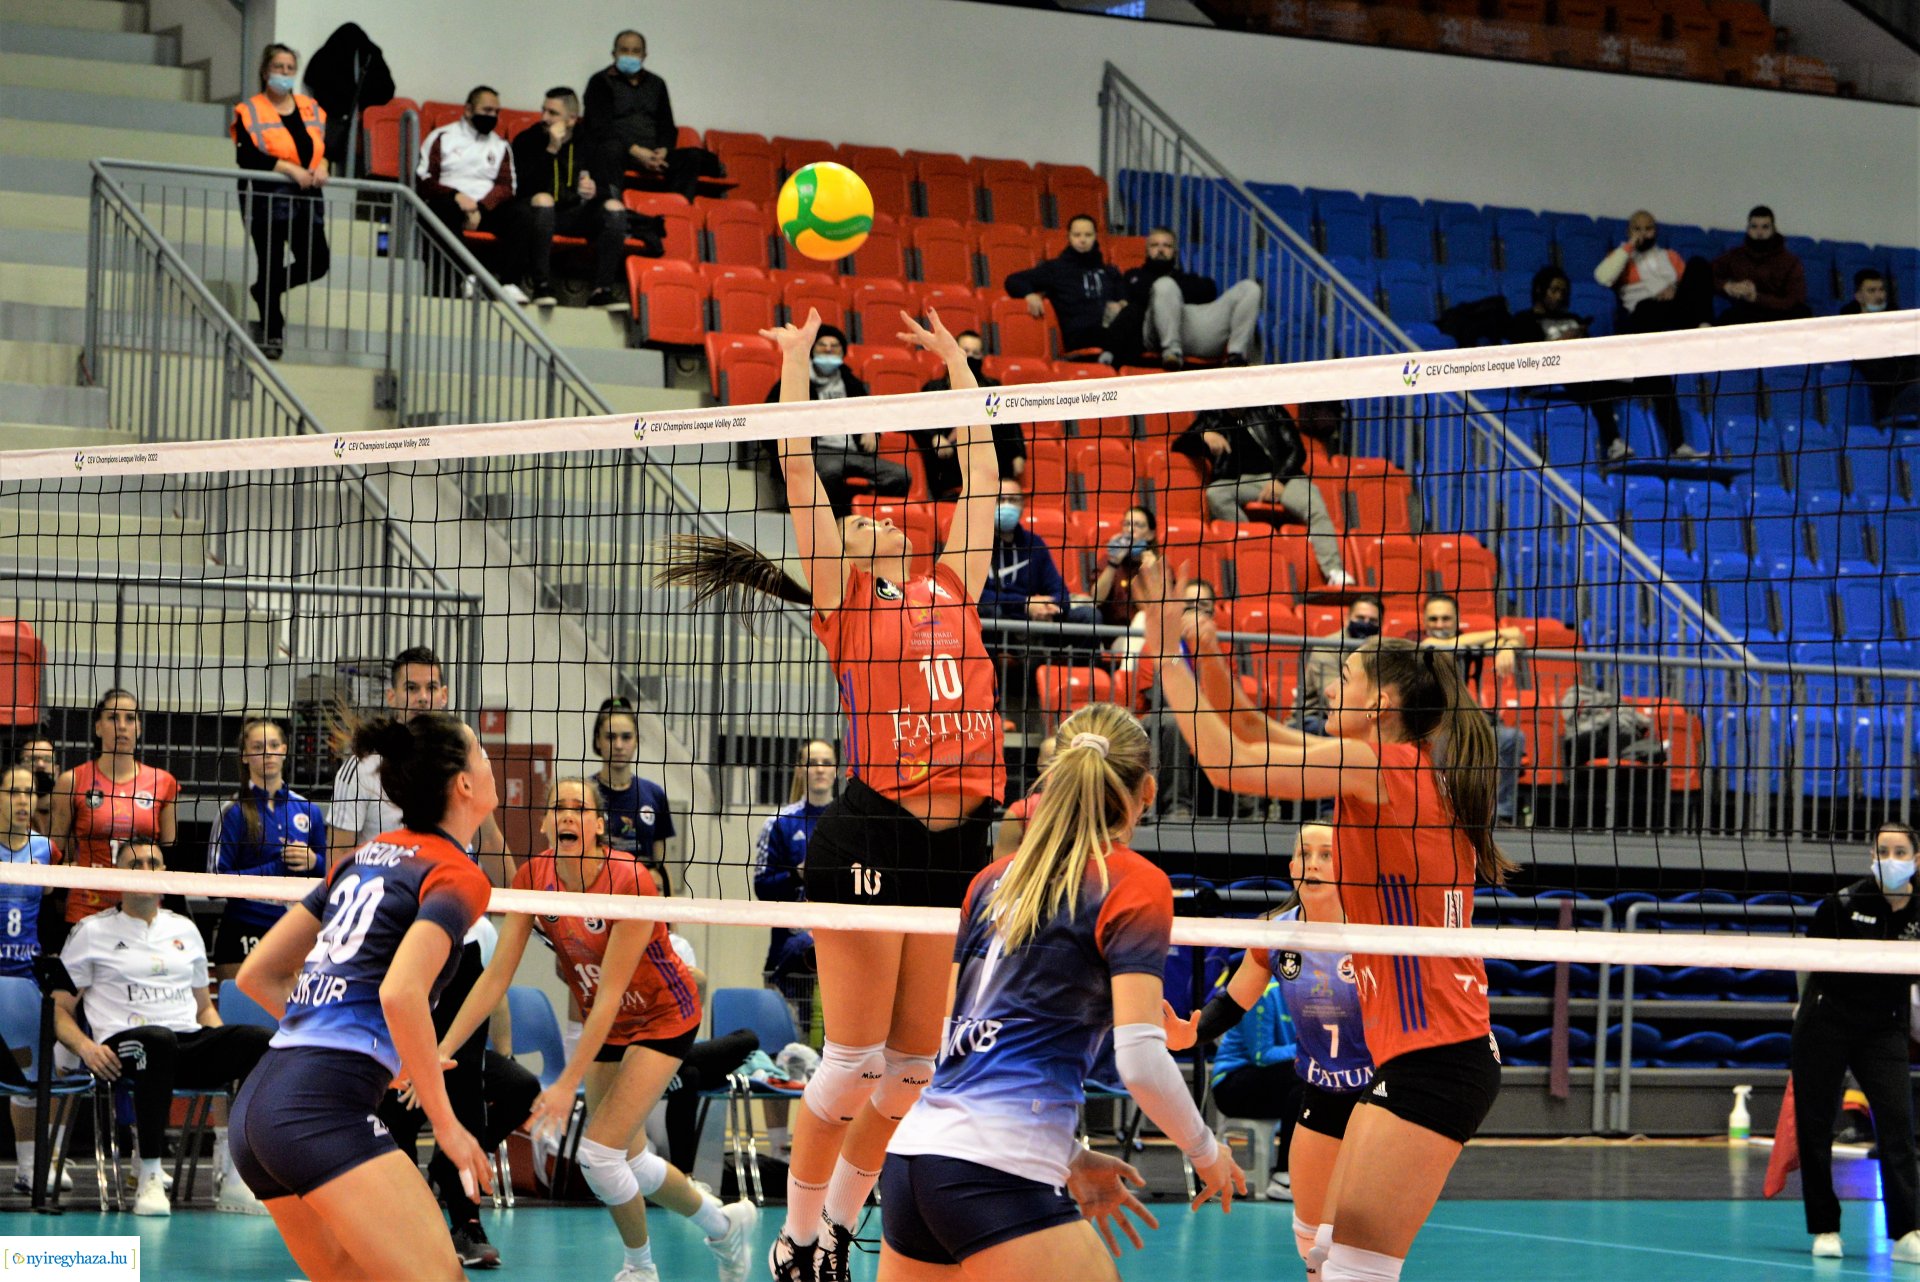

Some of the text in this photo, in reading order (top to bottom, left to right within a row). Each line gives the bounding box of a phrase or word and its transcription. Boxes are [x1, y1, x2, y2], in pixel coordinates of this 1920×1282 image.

[1425, 355, 1561, 376] CEV Champions League Volley 2022
[1005, 391, 1118, 408] CEV Champions League Volley 2022
[650, 417, 747, 432] CEV Champions League Volley 2022
[348, 438, 430, 451] CEV Champions League Volley 2022
[919, 653, 963, 701] 10
[888, 704, 994, 742] FATUM
[850, 862, 882, 896] 10
[7, 908, 21, 937] 8
[305, 874, 385, 964] 20
[1323, 1024, 1339, 1058] 7
